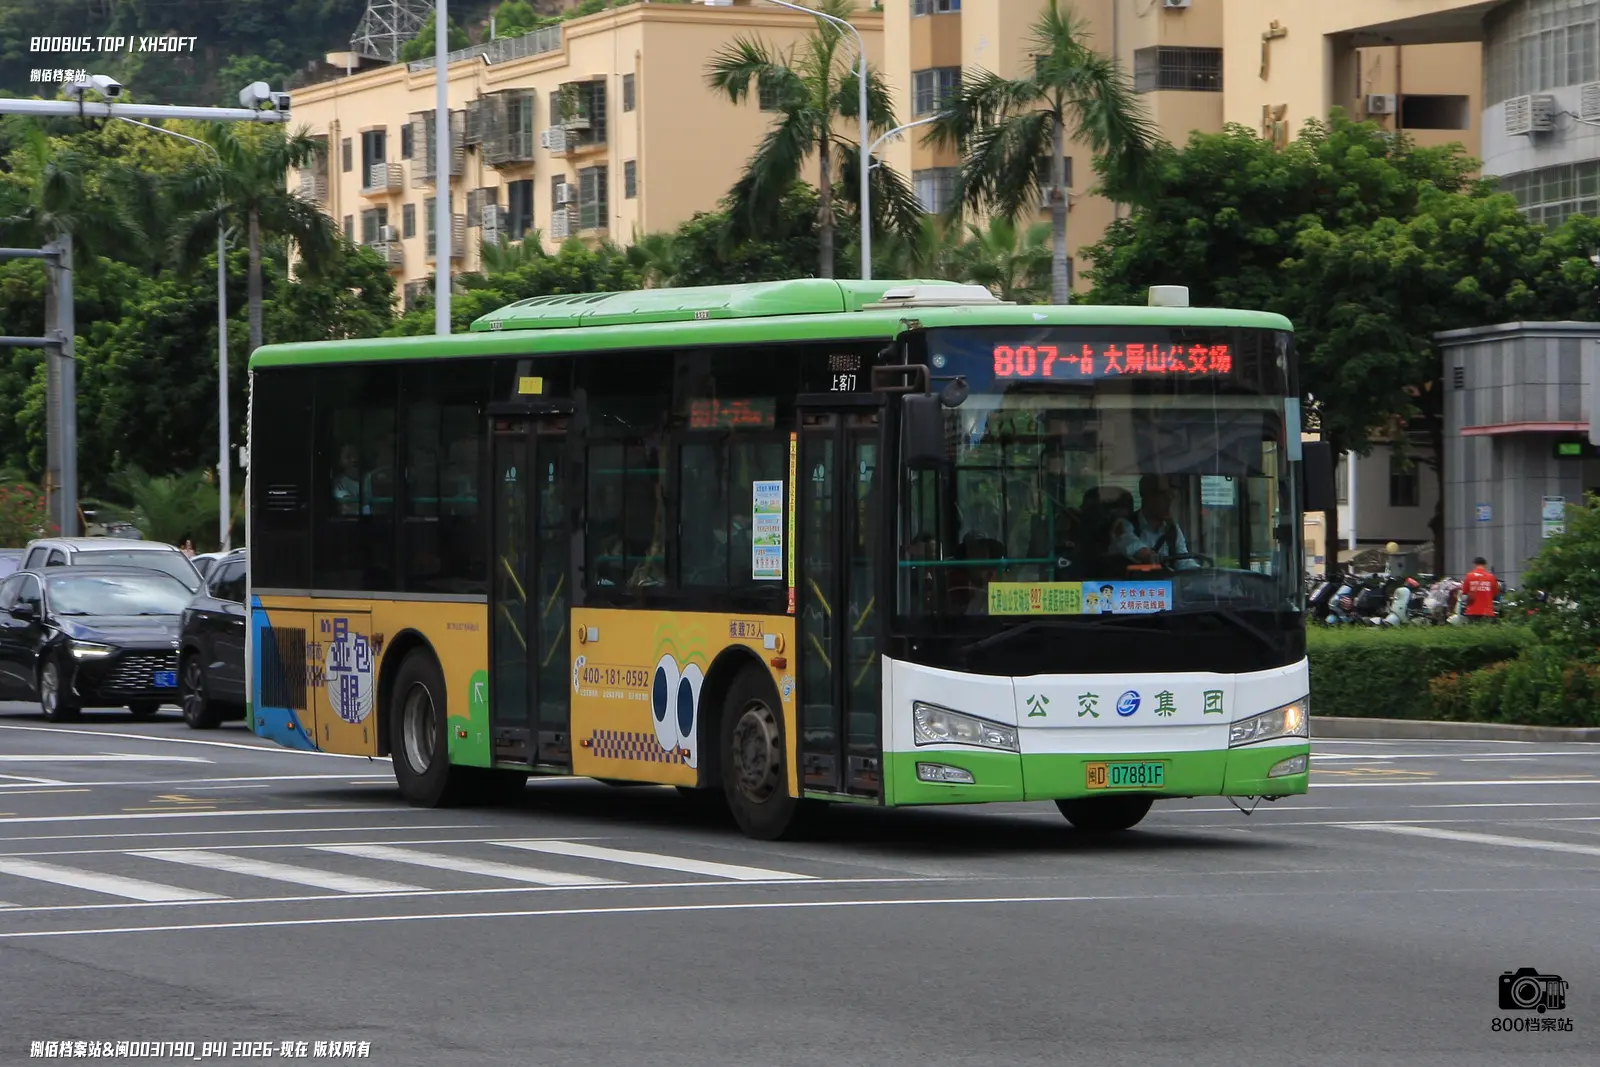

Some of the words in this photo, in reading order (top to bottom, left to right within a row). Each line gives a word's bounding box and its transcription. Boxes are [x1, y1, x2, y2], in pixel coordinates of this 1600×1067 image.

[993, 345, 1058, 376] 807
[830, 374, 856, 391] 上客门
[583, 667, 649, 687] 400-181-0592
